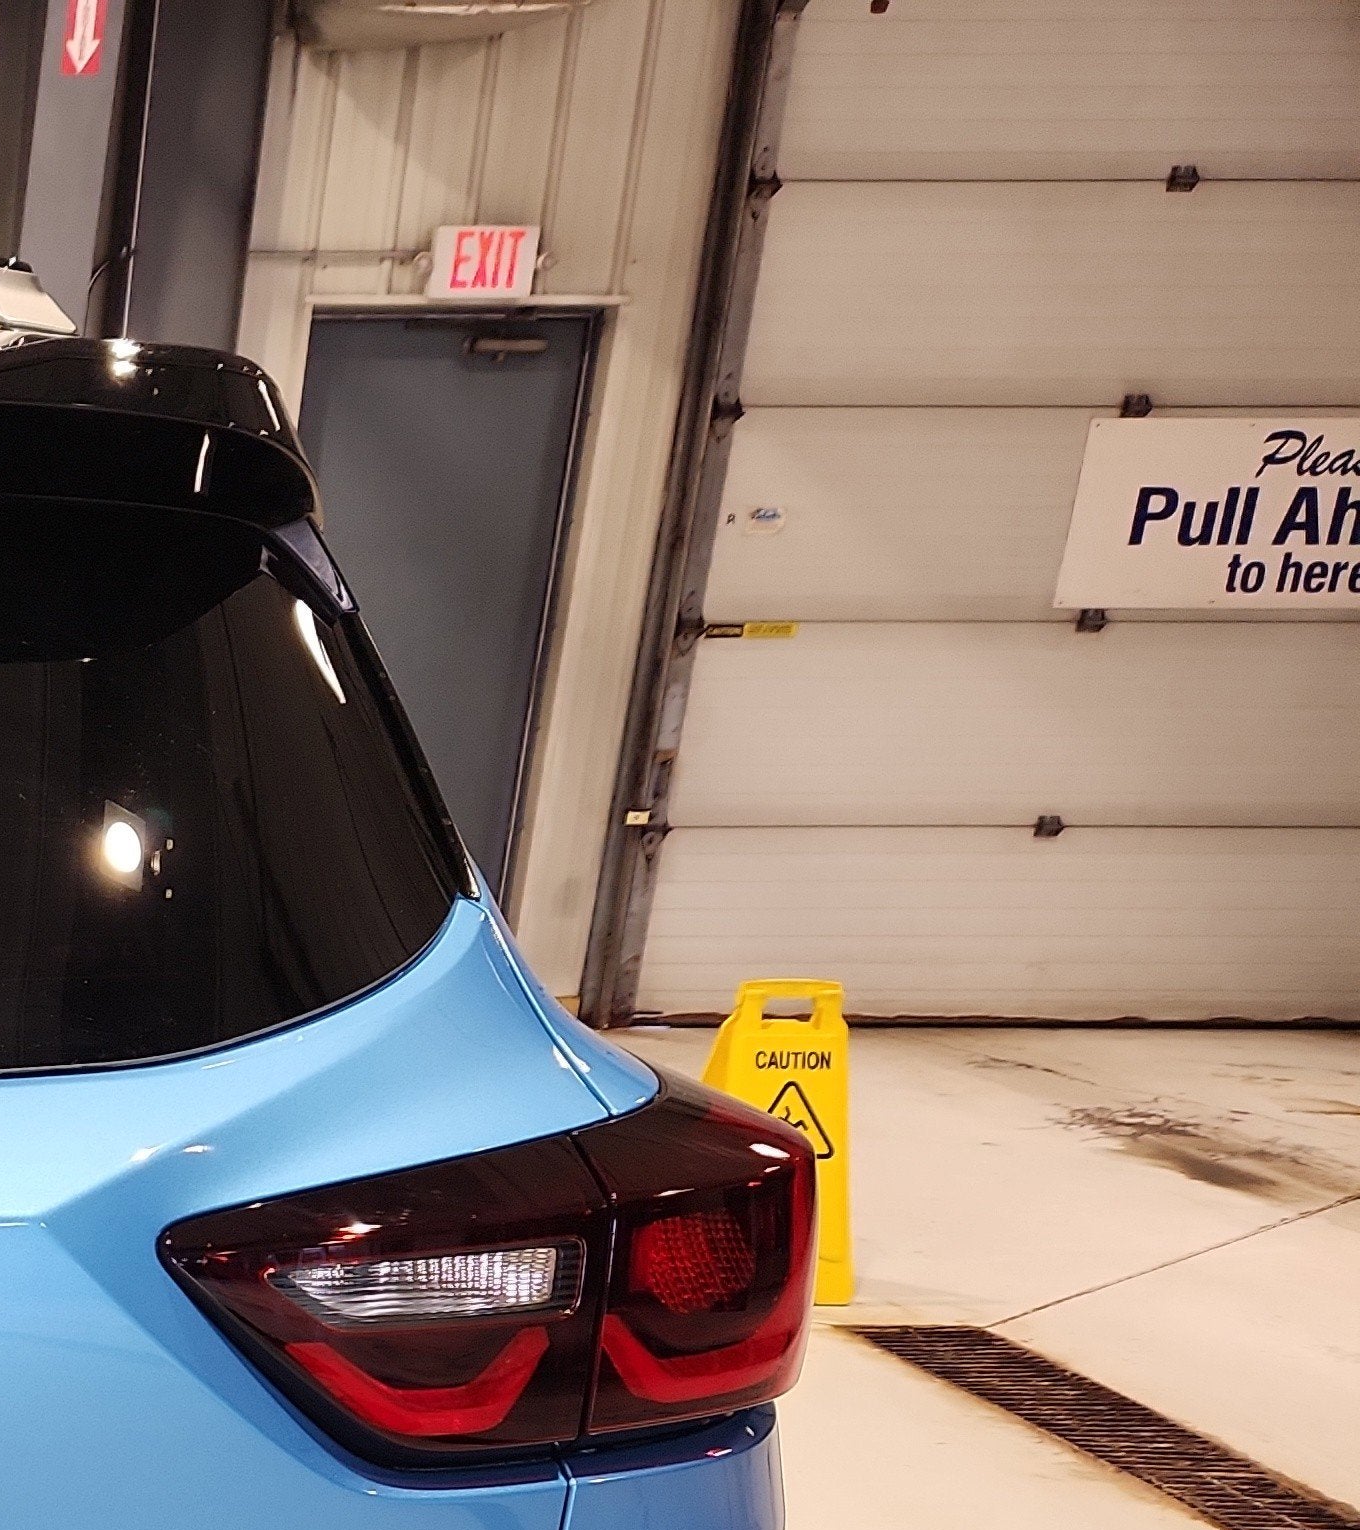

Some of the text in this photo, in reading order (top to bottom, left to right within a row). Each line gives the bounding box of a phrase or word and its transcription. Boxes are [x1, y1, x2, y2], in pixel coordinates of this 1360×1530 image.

[450, 231, 526, 289] EXIT
[1128, 486, 1260, 547] Pull
[1226, 553, 1266, 594] to
[755, 1050, 832, 1070] CAUTION
